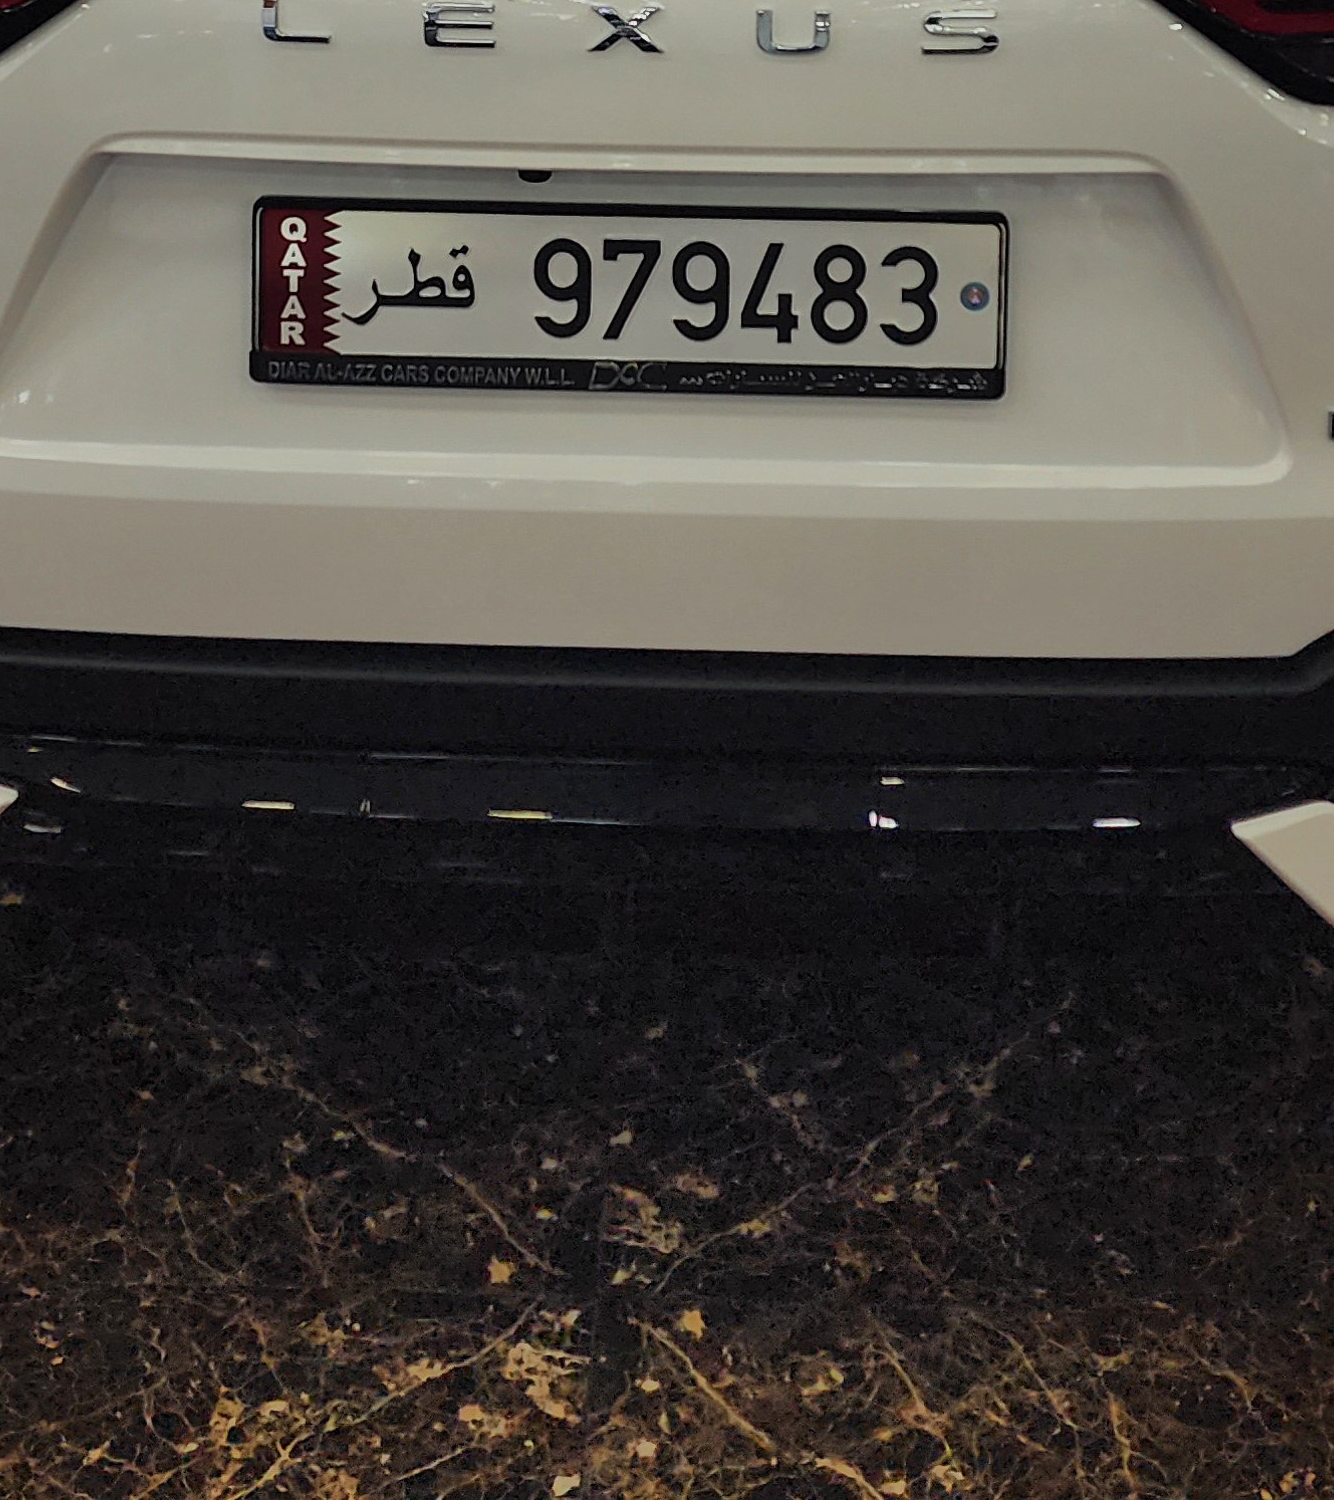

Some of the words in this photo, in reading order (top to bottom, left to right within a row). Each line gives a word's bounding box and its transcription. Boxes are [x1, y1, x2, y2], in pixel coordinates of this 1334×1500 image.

[279, 216, 308, 346] QATAR
[341, 244, 476, 326] قطر
[533, 238, 939, 346] 979483
[268, 361, 311, 380] DIAR
[313, 362, 377, 382] AL-AZZ
[380, 363, 430, 384] CARS
[433, 364, 522, 386] COMPANY
